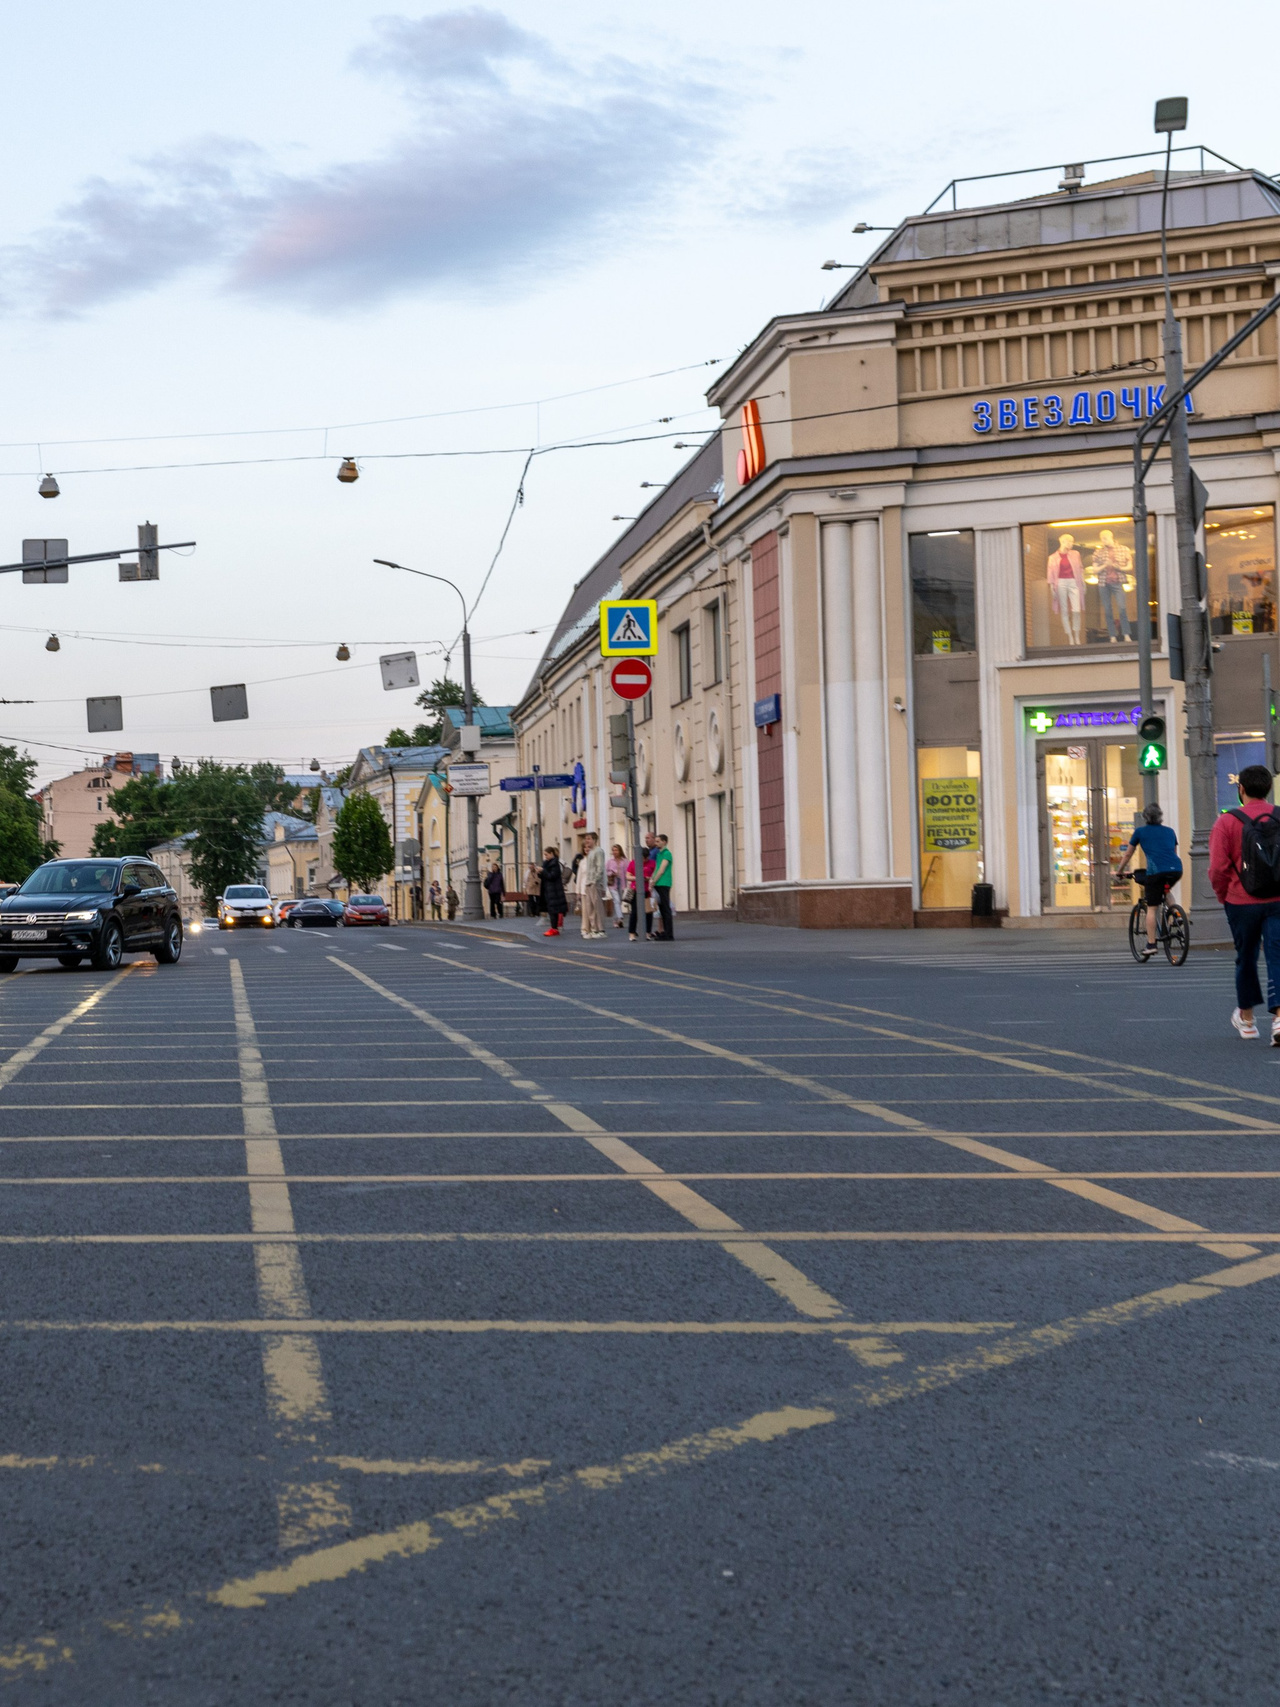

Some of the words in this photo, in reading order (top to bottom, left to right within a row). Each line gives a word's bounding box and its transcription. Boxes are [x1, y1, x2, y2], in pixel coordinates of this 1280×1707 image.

[1232, 610, 1252, 619] NEW
[932, 629, 951, 638] NEW
[1055, 711, 1130, 728] АПТЕКА
[926, 794, 976, 807] ФОТО
[927, 828, 977, 838] ПЕЧАТЬ
